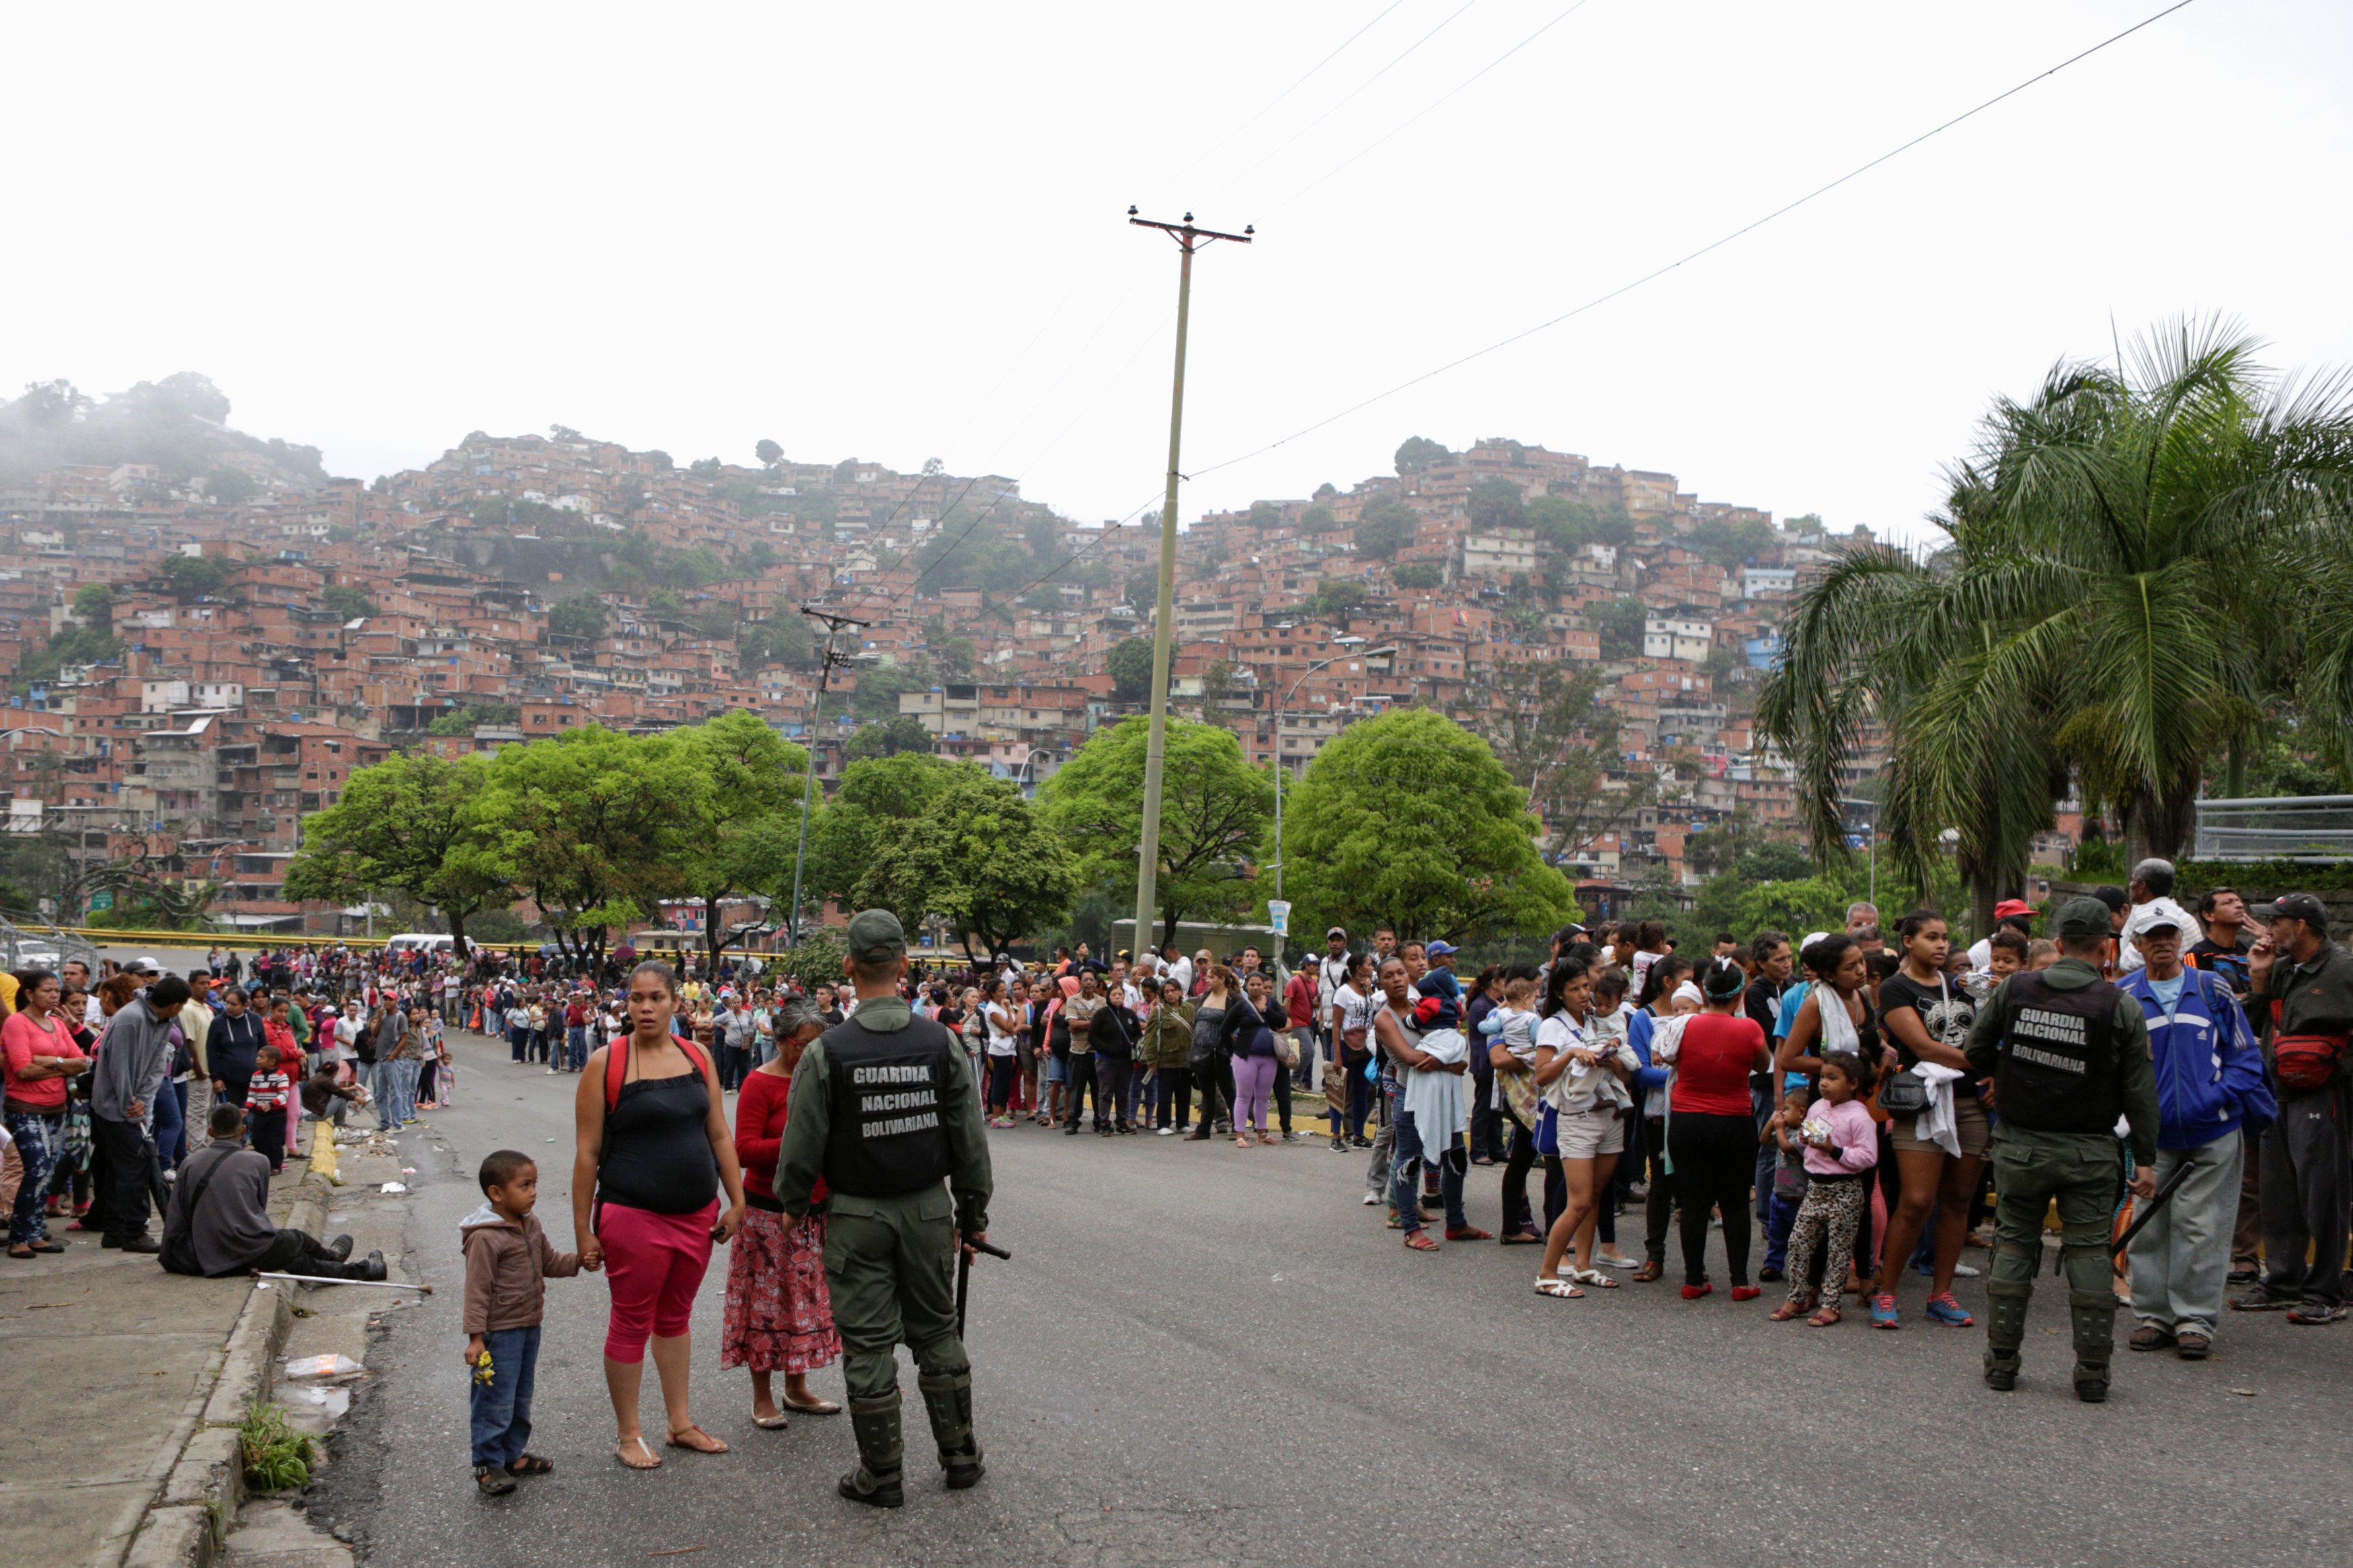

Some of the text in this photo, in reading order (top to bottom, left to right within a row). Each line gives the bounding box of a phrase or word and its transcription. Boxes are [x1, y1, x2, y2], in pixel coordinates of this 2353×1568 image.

[2020, 1008, 2085, 1030] GUARDIA
[2013, 1020, 2087, 1045] NACIONAL
[2012, 1044, 2086, 1074] BOLIVARIANA
[853, 1065, 930, 1083] GUARDIA
[862, 1089, 938, 1112] NACIONAL
[862, 1112, 940, 1138] BOLIVARIANA
